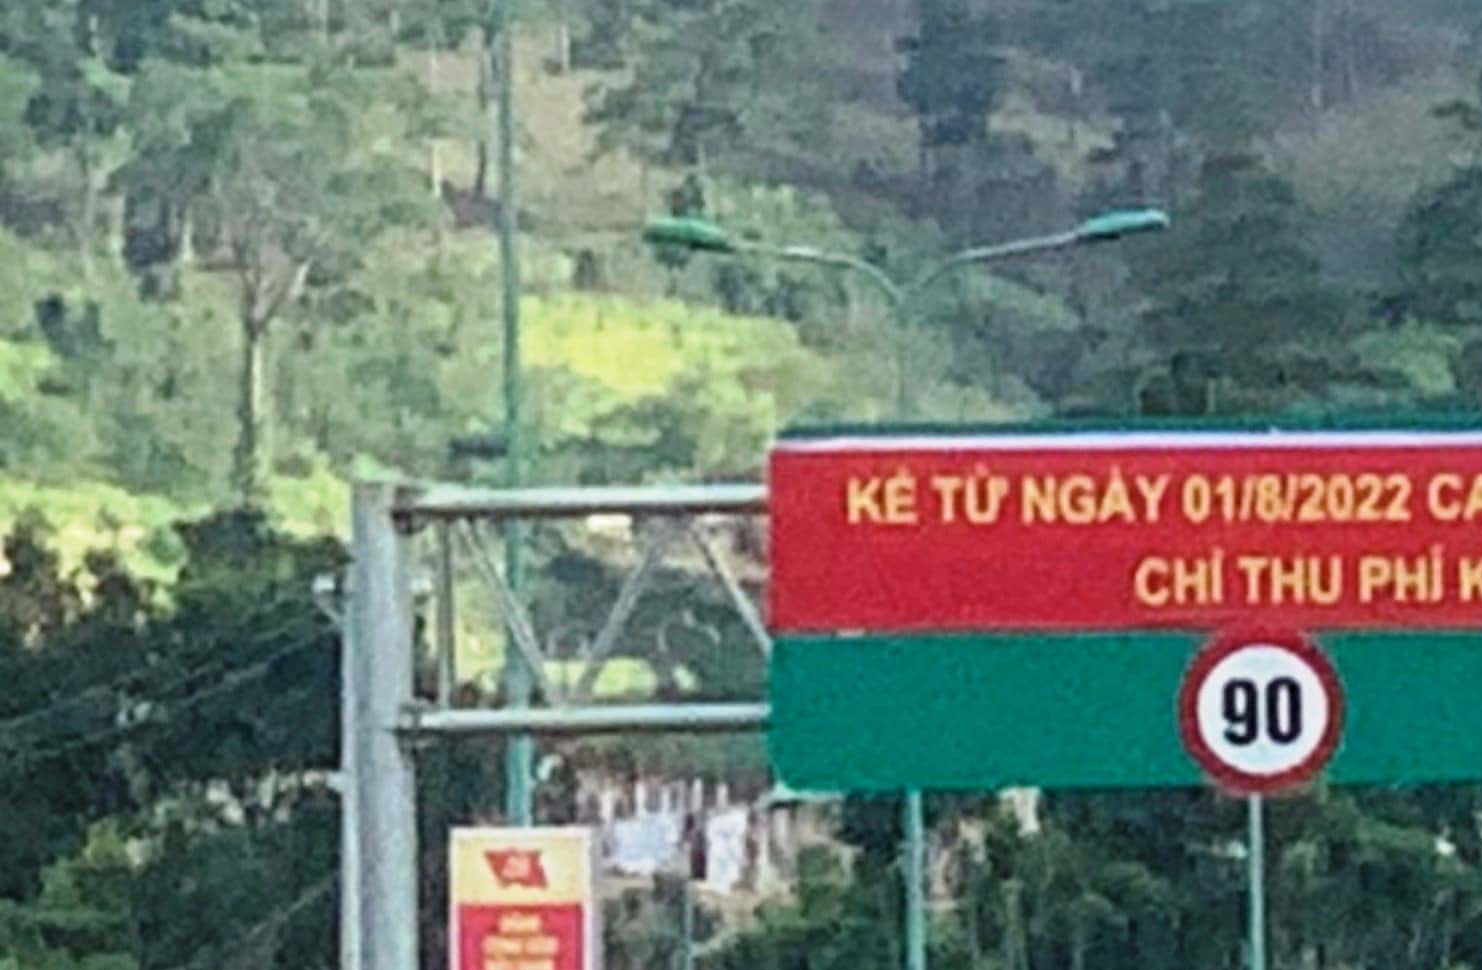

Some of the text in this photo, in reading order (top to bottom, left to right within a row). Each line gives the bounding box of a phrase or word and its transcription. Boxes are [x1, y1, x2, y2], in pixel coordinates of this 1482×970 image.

[931, 460, 1009, 524] TỪ
[1021, 463, 1169, 524] NGÀY
[1182, 473, 1412, 523] 01/8/2022
[1237, 555, 1343, 604] THU
[1359, 543, 1444, 603] PHÍ
[1221, 676, 1303, 747] 90
